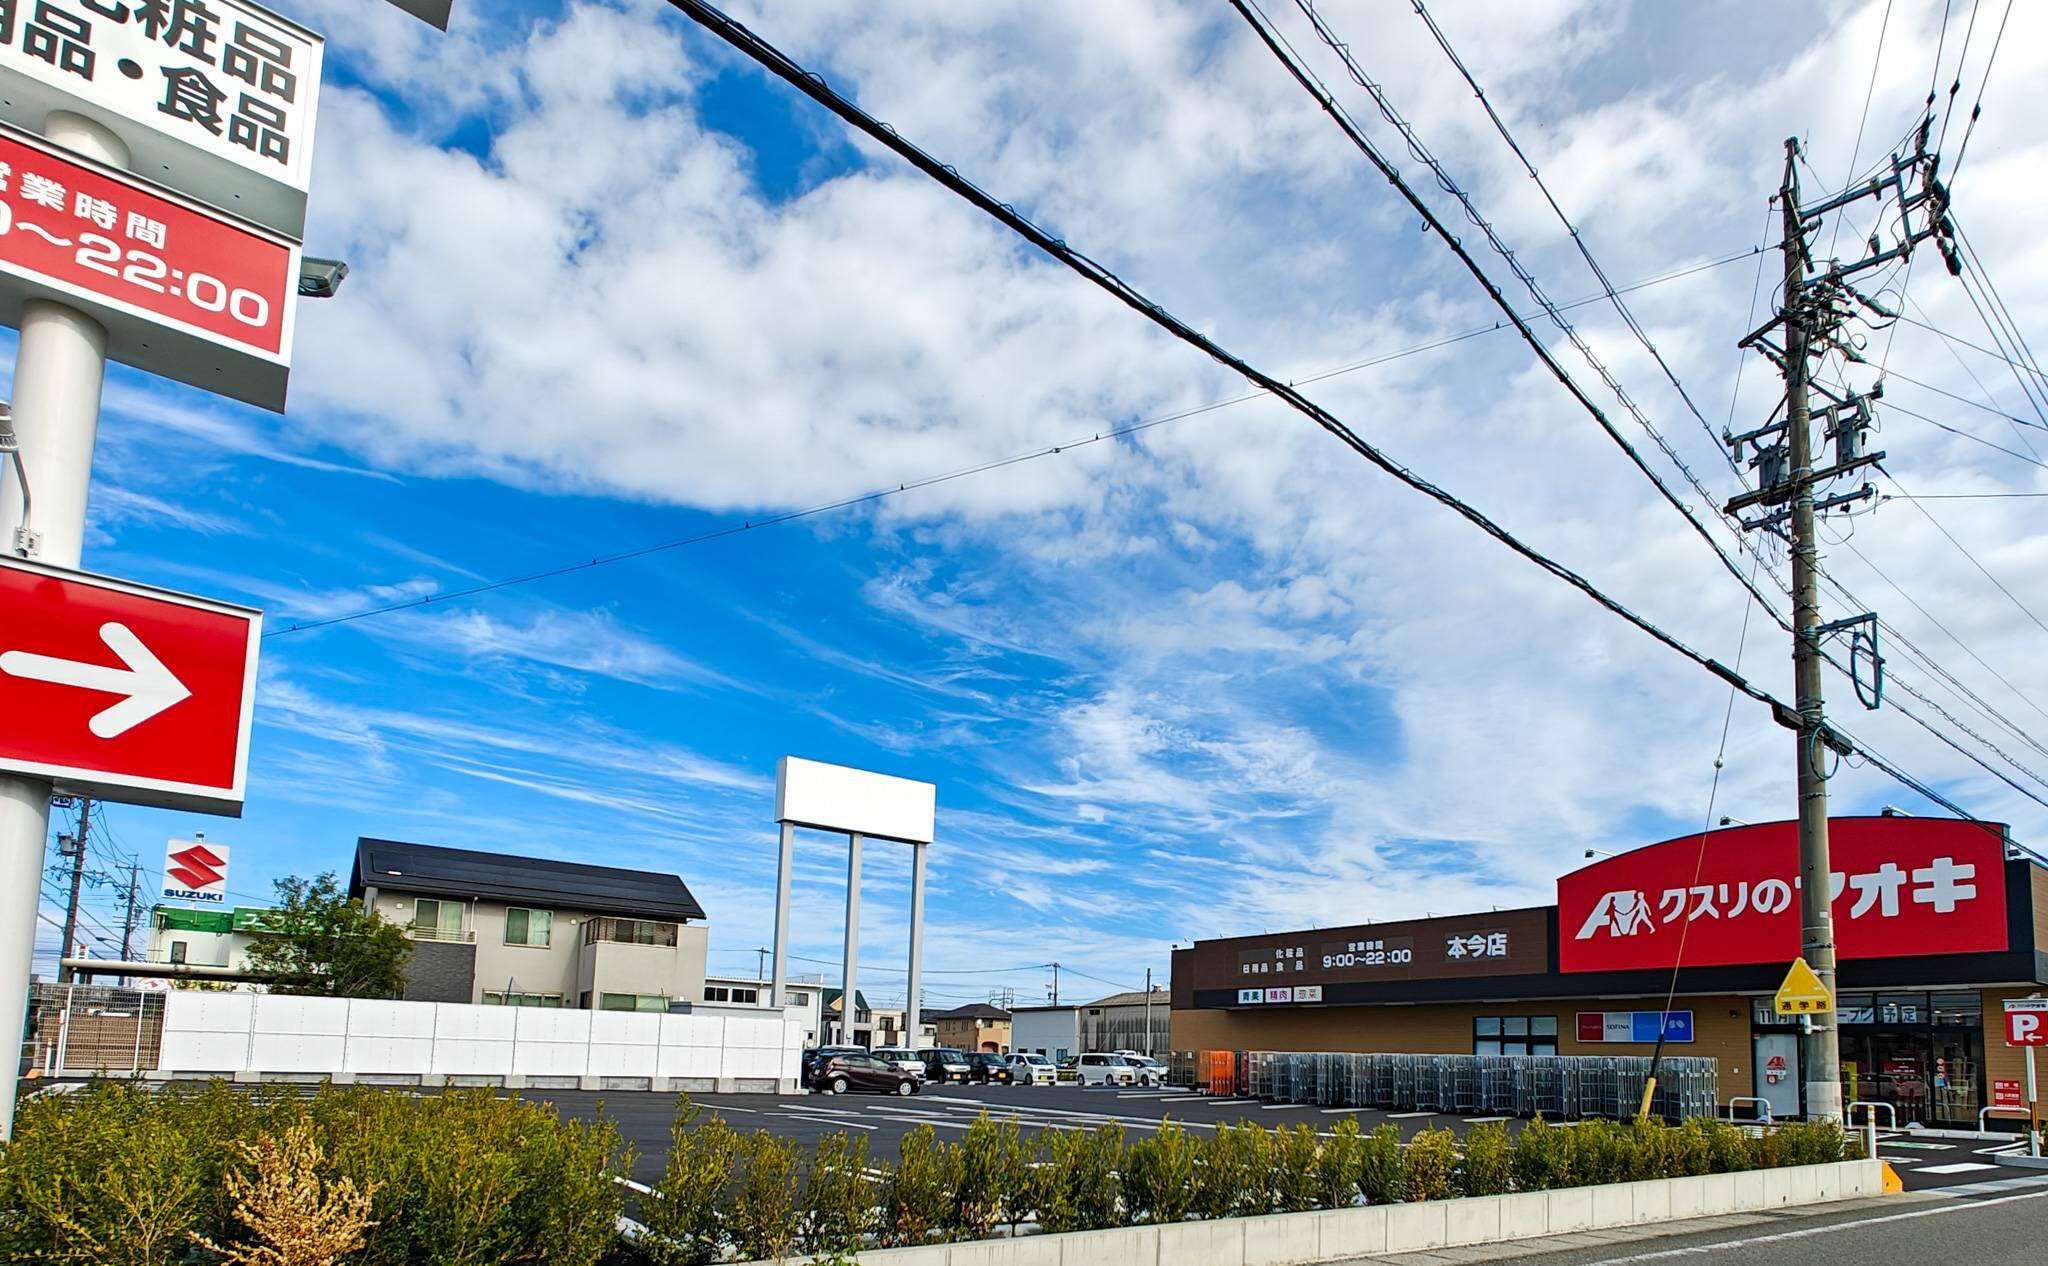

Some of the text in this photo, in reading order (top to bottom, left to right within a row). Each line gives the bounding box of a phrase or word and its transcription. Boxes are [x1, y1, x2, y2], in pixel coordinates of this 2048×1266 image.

[78, 0, 298, 104] 粧品
[0, 0, 291, 167] 品・食品
[0, 161, 168, 251] 業時間
[163, 888, 223, 902] SUZUKI
[1275, 947, 1304, 959] 化粧品
[1348, 940, 1384, 952] 営業時間
[1446, 933, 1508, 960] 本今店
[1242, 962, 1269, 974] 日用品
[1781, 1000, 1827, 1011] 通学路
[1884, 1007, 1916, 1022] 予定
[2012, 1014, 2040, 1041] P
